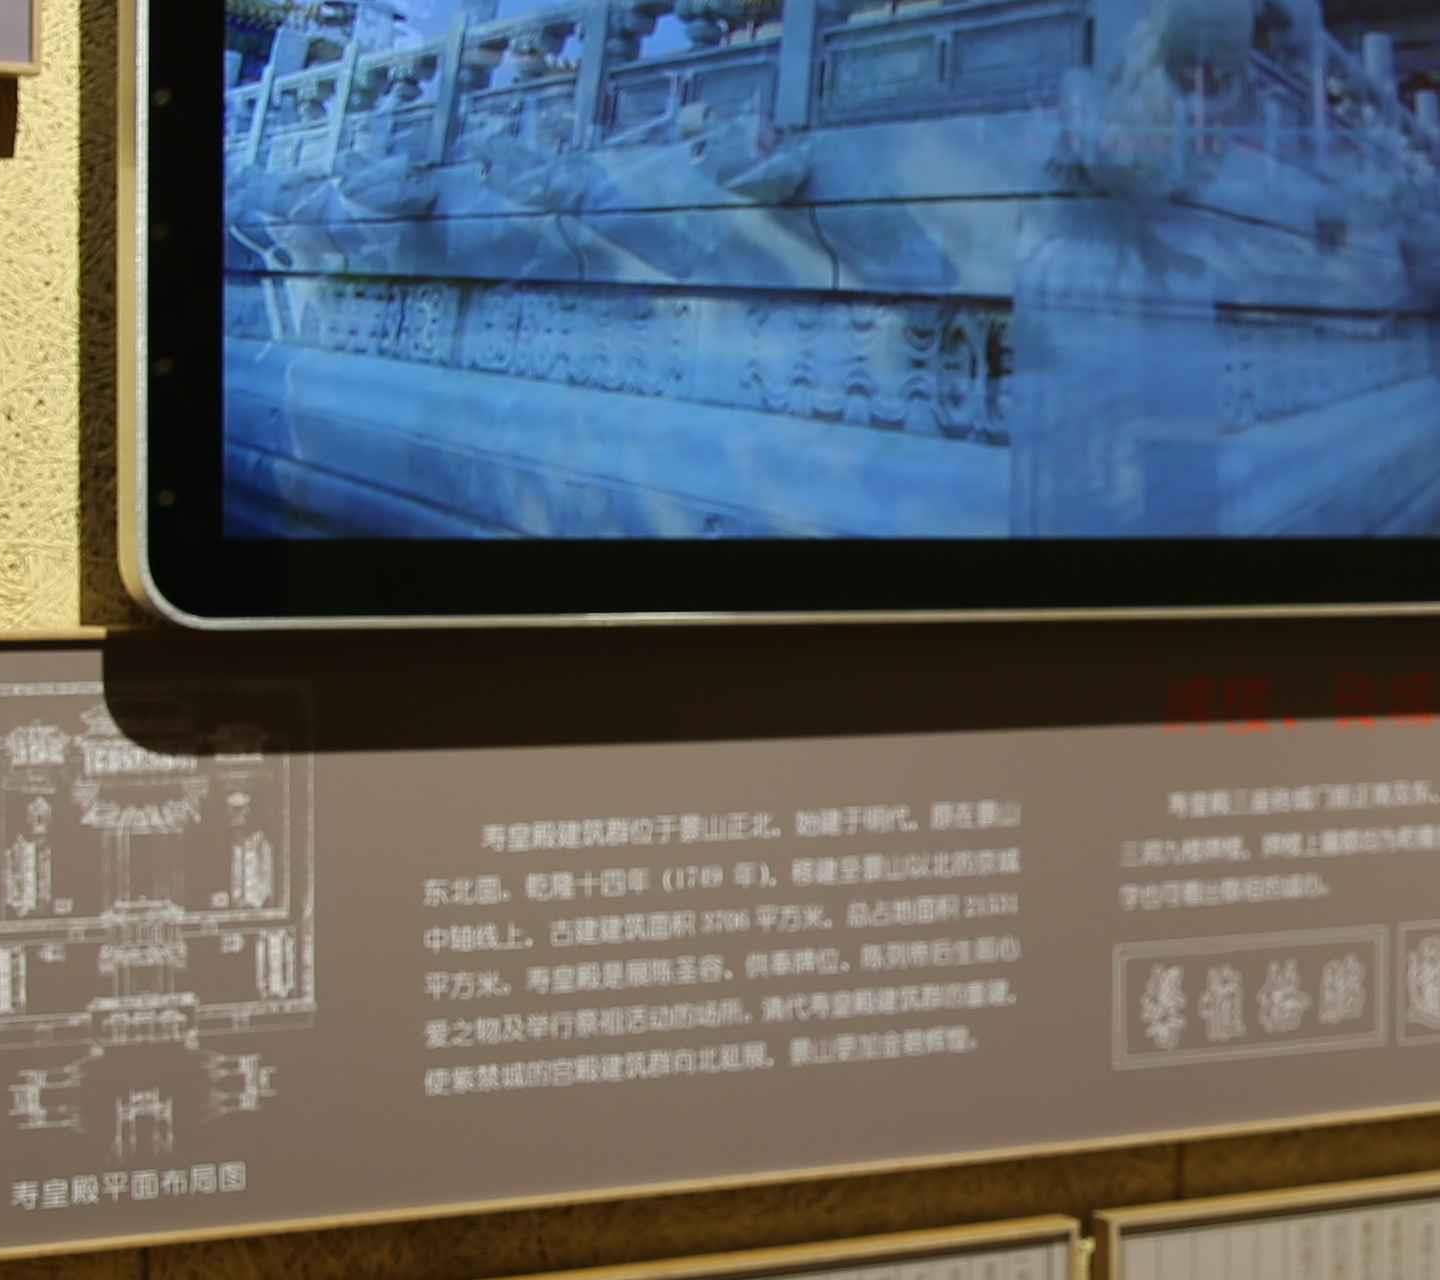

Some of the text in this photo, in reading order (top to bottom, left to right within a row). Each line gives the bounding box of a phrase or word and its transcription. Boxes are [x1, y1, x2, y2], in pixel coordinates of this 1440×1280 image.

[11, 1160, 247, 1211] 寿皇殿平面布局图
